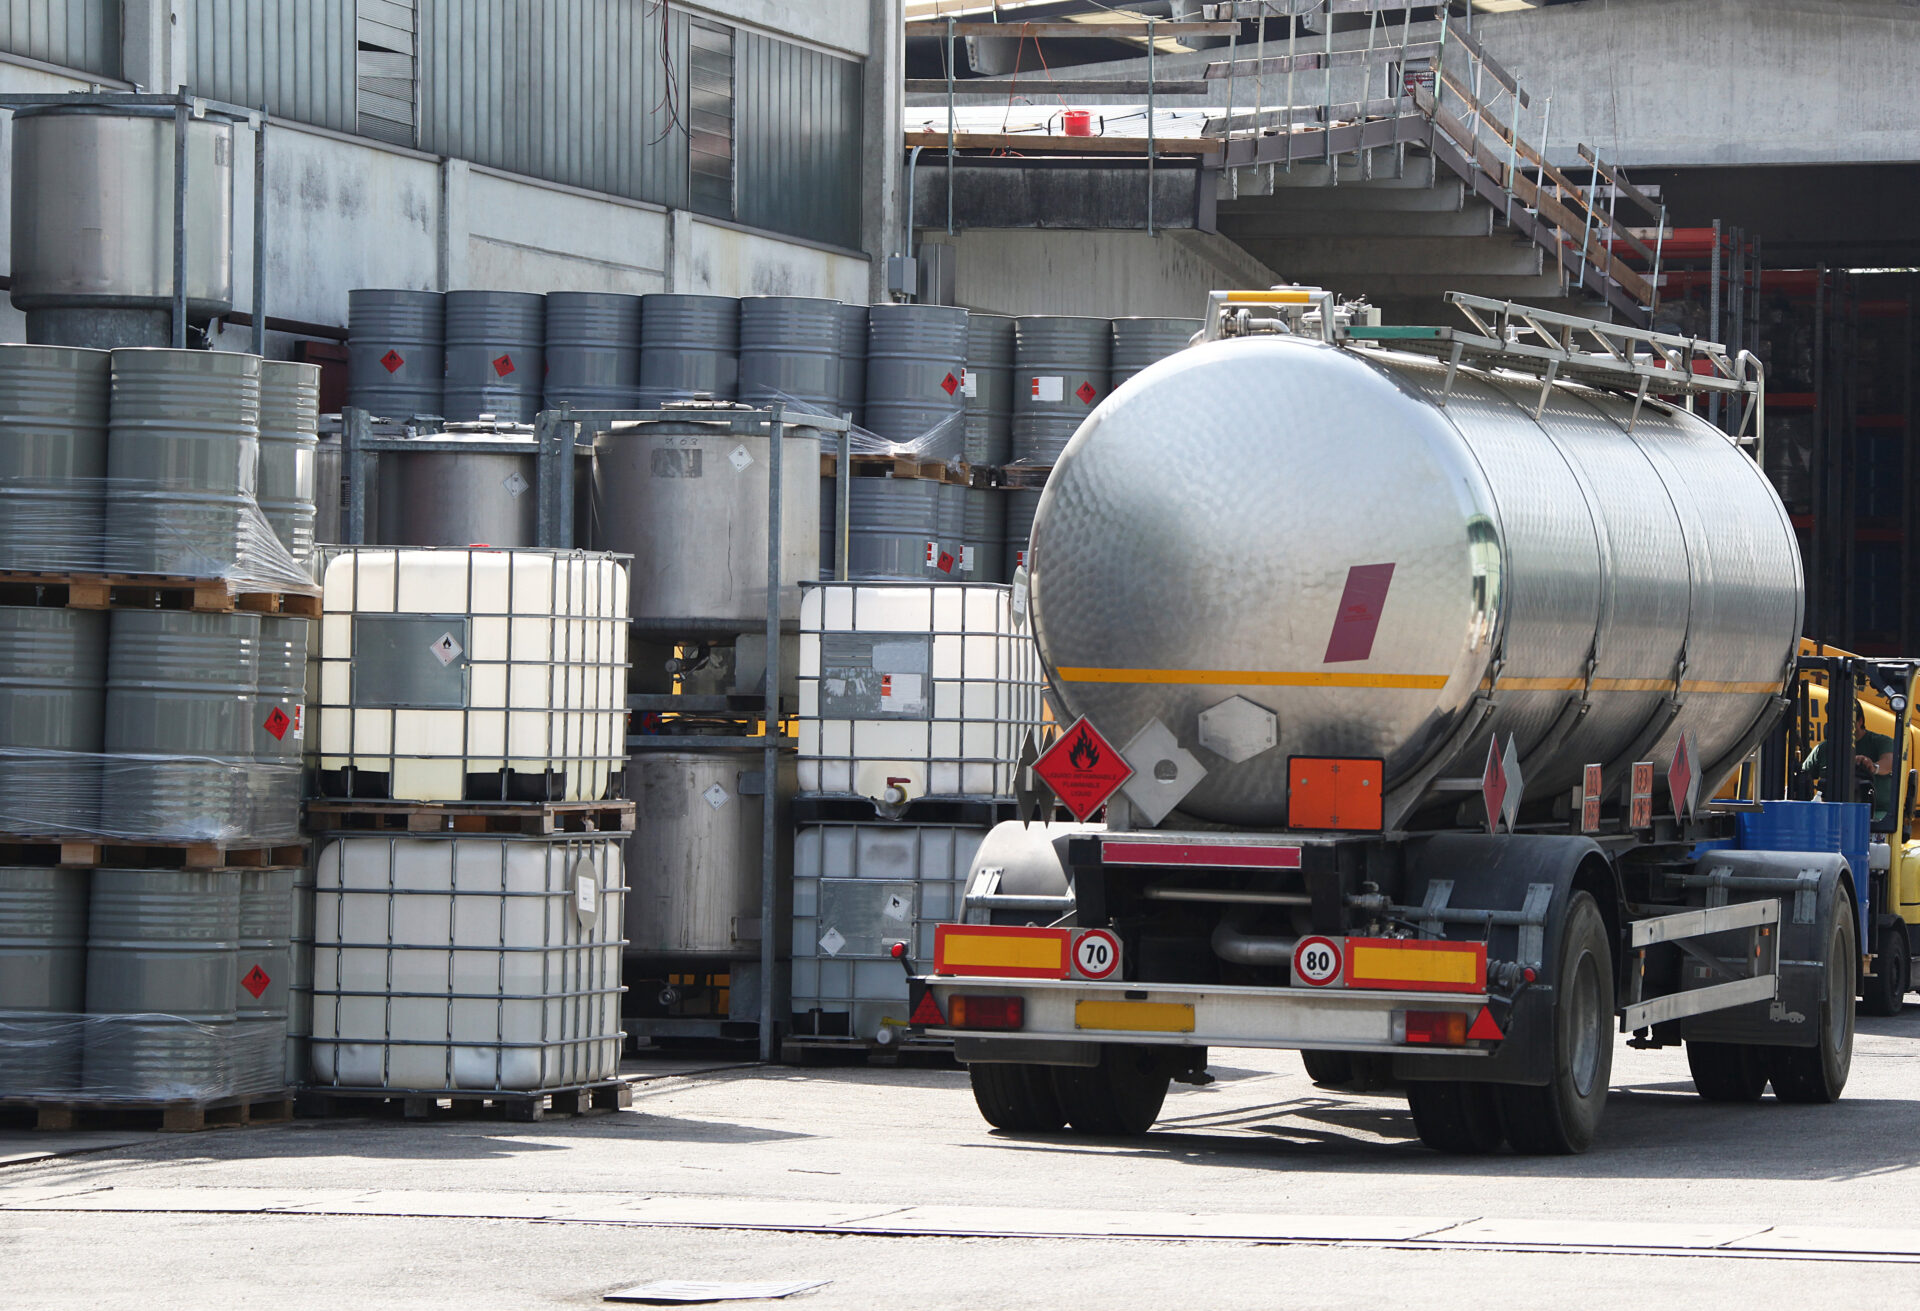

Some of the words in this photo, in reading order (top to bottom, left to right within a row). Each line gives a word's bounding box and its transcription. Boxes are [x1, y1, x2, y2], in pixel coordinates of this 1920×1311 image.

[1078, 803, 1085, 813] 3
[1086, 944, 1107, 964] 70
[1306, 951, 1329, 971] 80
